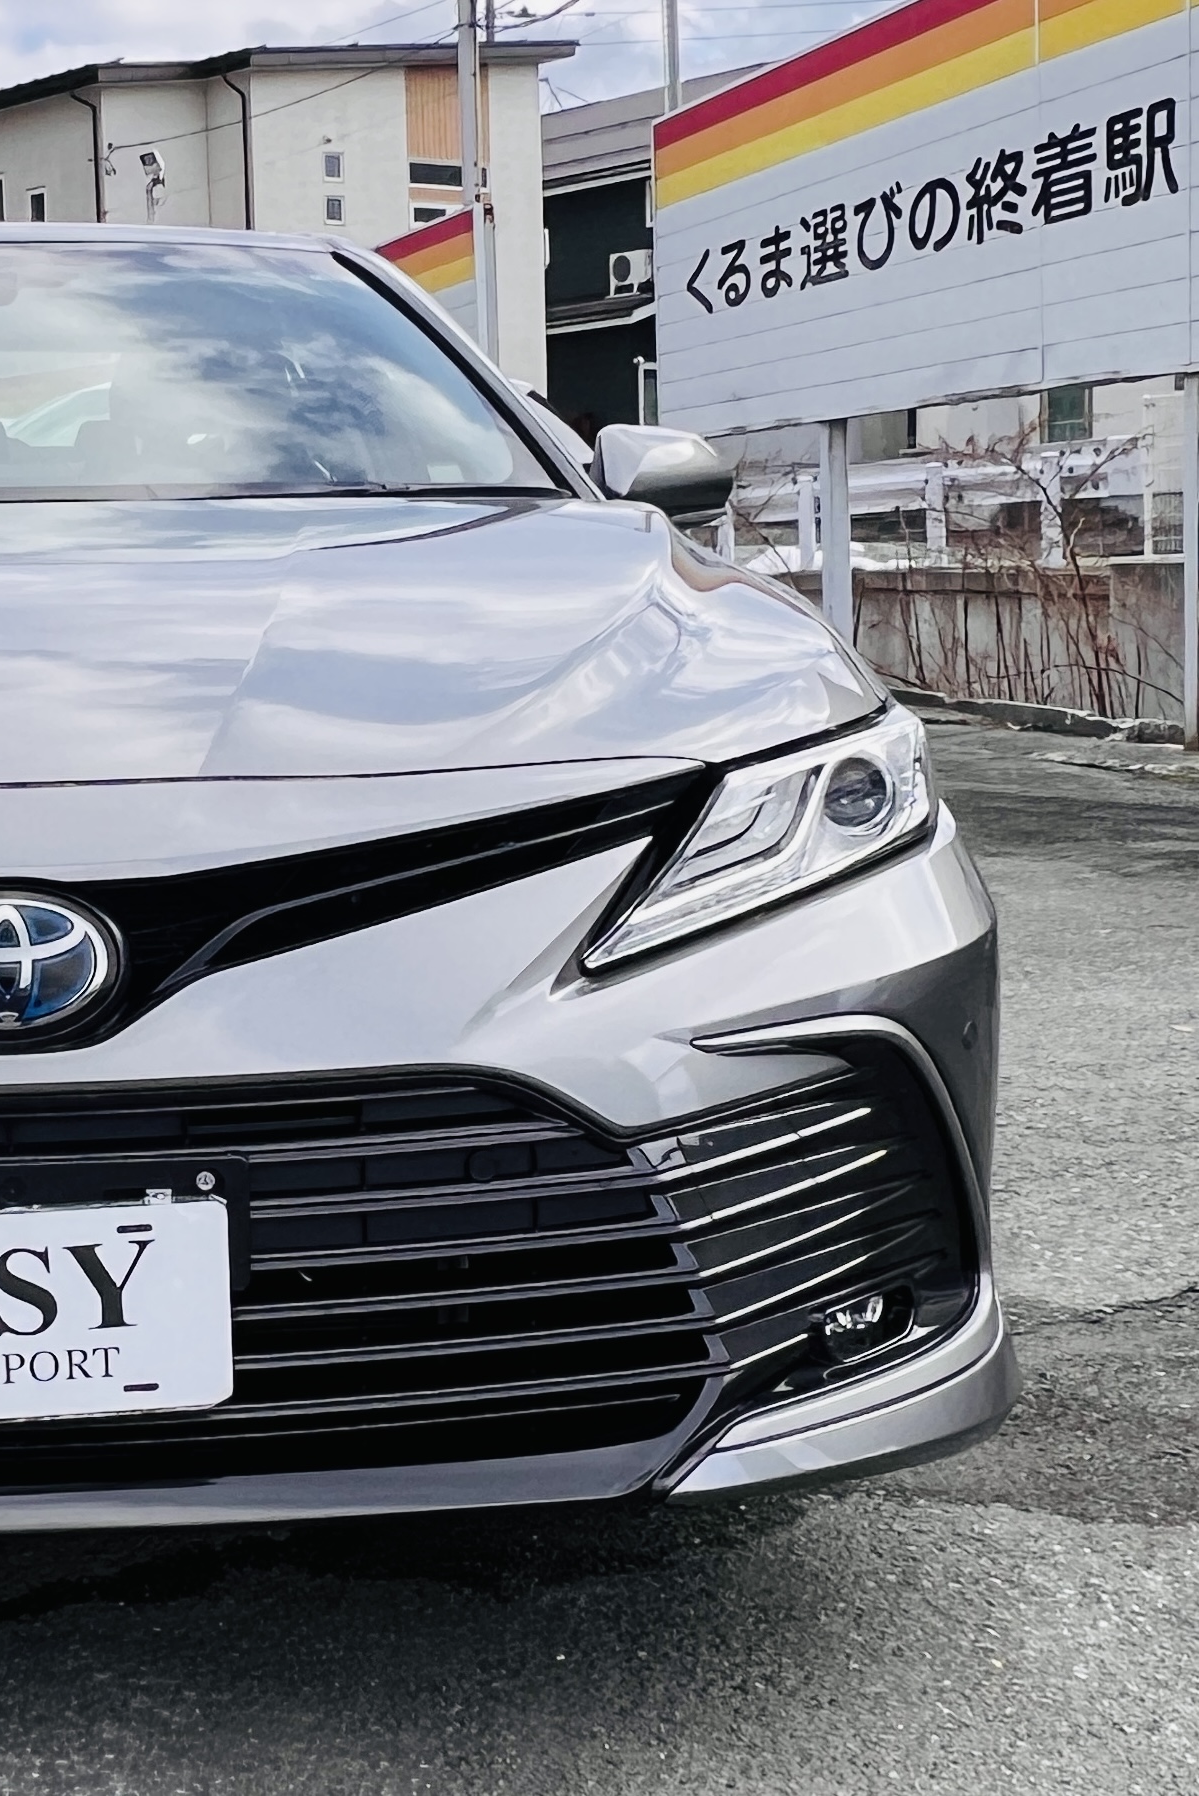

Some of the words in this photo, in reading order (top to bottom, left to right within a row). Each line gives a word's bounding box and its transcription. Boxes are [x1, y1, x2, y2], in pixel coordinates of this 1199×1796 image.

[686, 97, 1180, 314] くるま選びの終着駅
